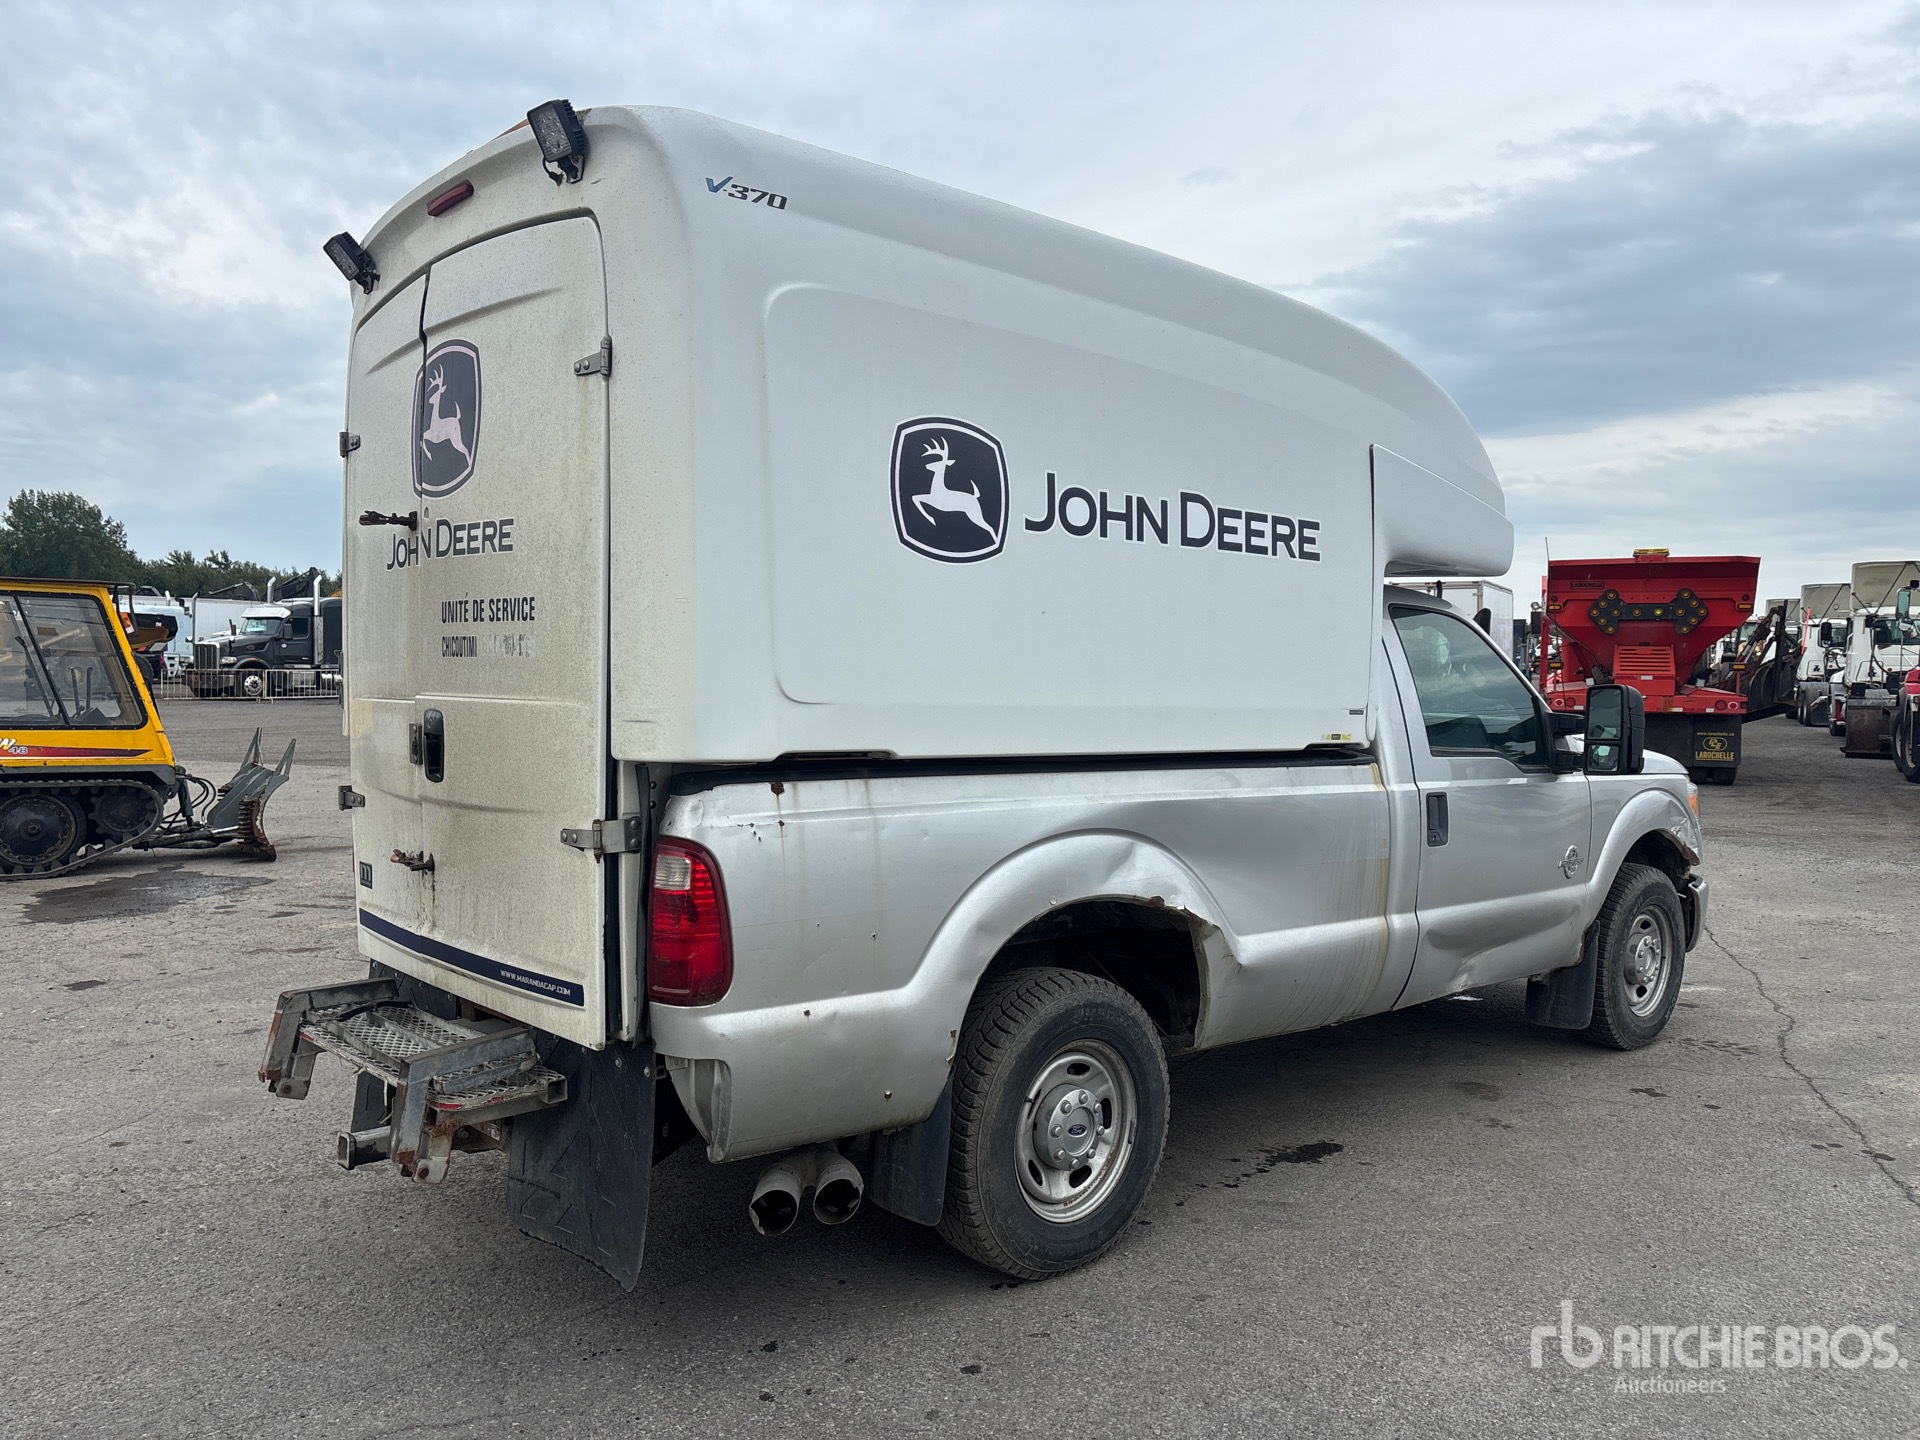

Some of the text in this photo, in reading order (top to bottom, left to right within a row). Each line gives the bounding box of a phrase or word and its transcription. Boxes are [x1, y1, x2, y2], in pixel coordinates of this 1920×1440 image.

[705, 176, 787, 209] V-370
[1025, 472, 1321, 562] JOHN DEERE
[386, 518, 514, 570] JOHN DEERE
[441, 592, 535, 623] UNITÉ DE SERVICE
[441, 636, 478, 658] CHICOUTIMI
[1695, 751, 1735, 760] LAROCHELLE
